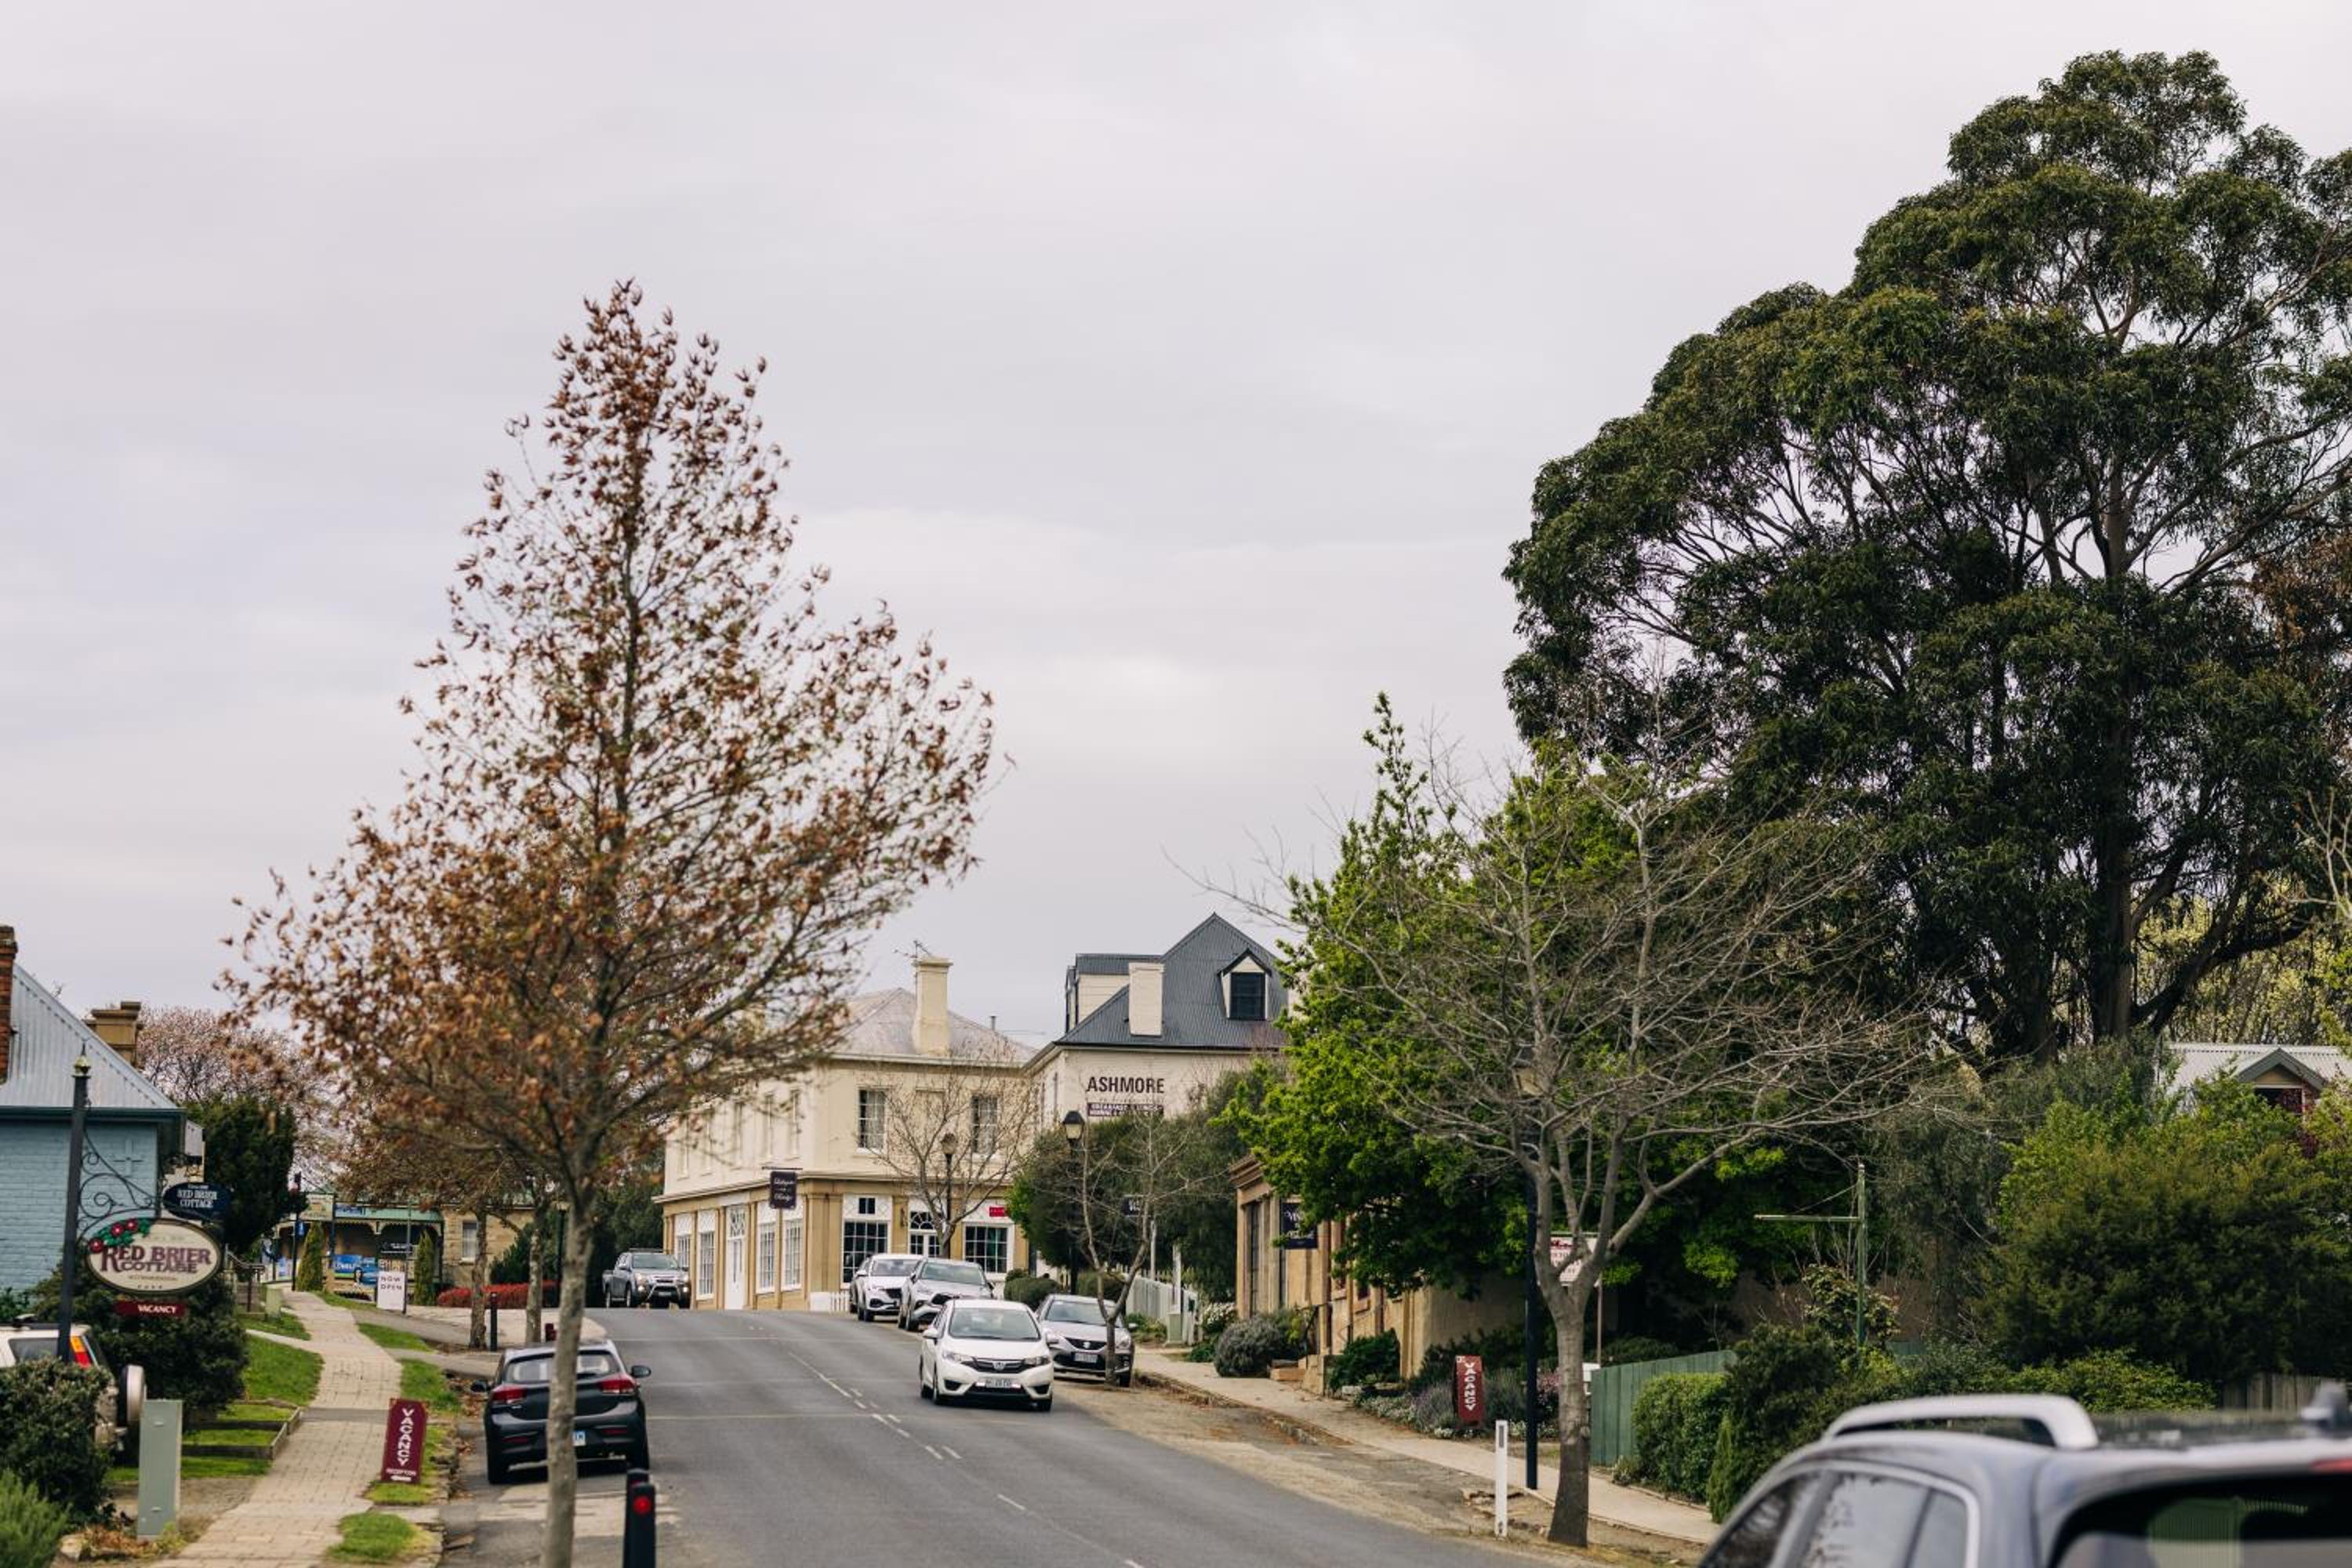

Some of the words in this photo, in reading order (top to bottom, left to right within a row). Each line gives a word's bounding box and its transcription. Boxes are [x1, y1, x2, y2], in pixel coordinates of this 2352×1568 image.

[1087, 1076, 1165, 1094] ASHMORE
[176, 1189, 194, 1199] RED
[180, 1199, 213, 1208] COTTAGE
[101, 1246, 145, 1273] RED
[151, 1247, 212, 1265] BRIER
[122, 1261, 198, 1273] COTTAGE
[137, 1305, 177, 1314] VACANCY
[1464, 1363, 1476, 1411] VACANCY
[397, 1408, 414, 1467] VACANCY
